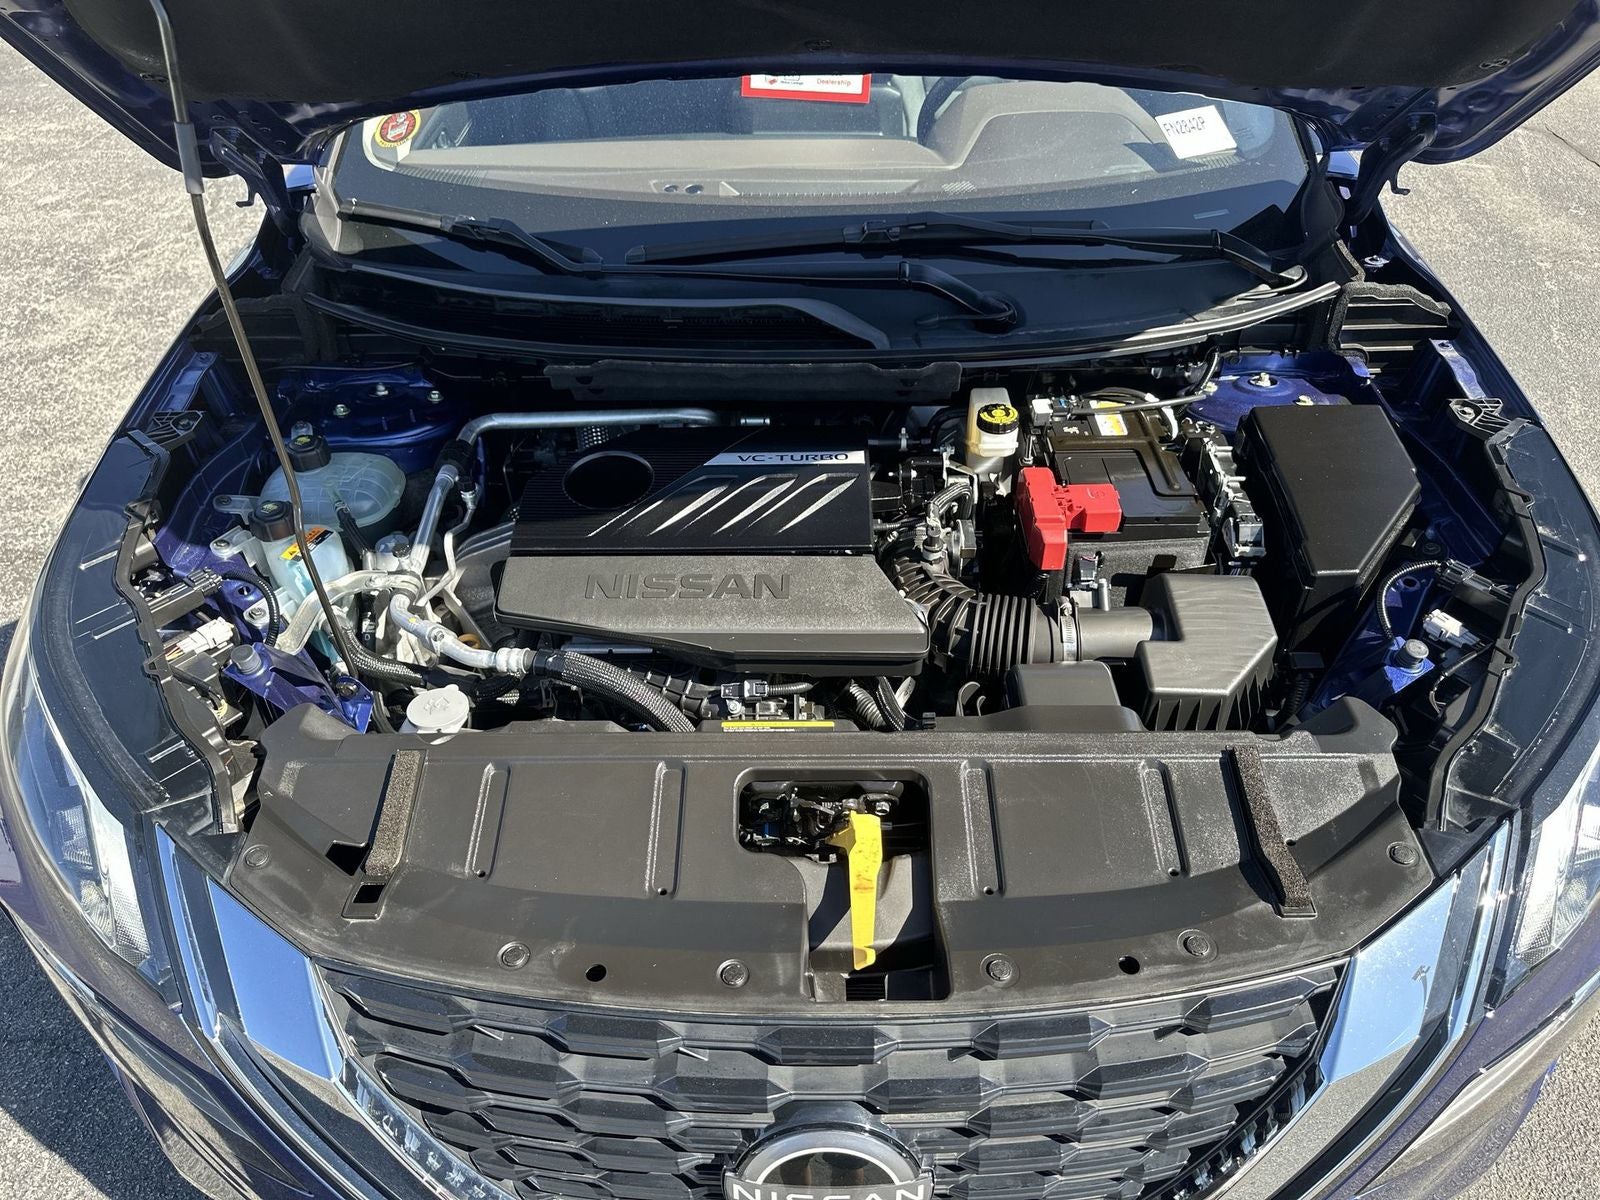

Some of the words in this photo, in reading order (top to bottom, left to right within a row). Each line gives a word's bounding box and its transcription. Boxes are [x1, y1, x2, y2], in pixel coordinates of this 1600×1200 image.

[816, 78, 852, 87] Dealership
[737, 453, 849, 462] VC-TURBO
[584, 573, 791, 600] NISSAN
